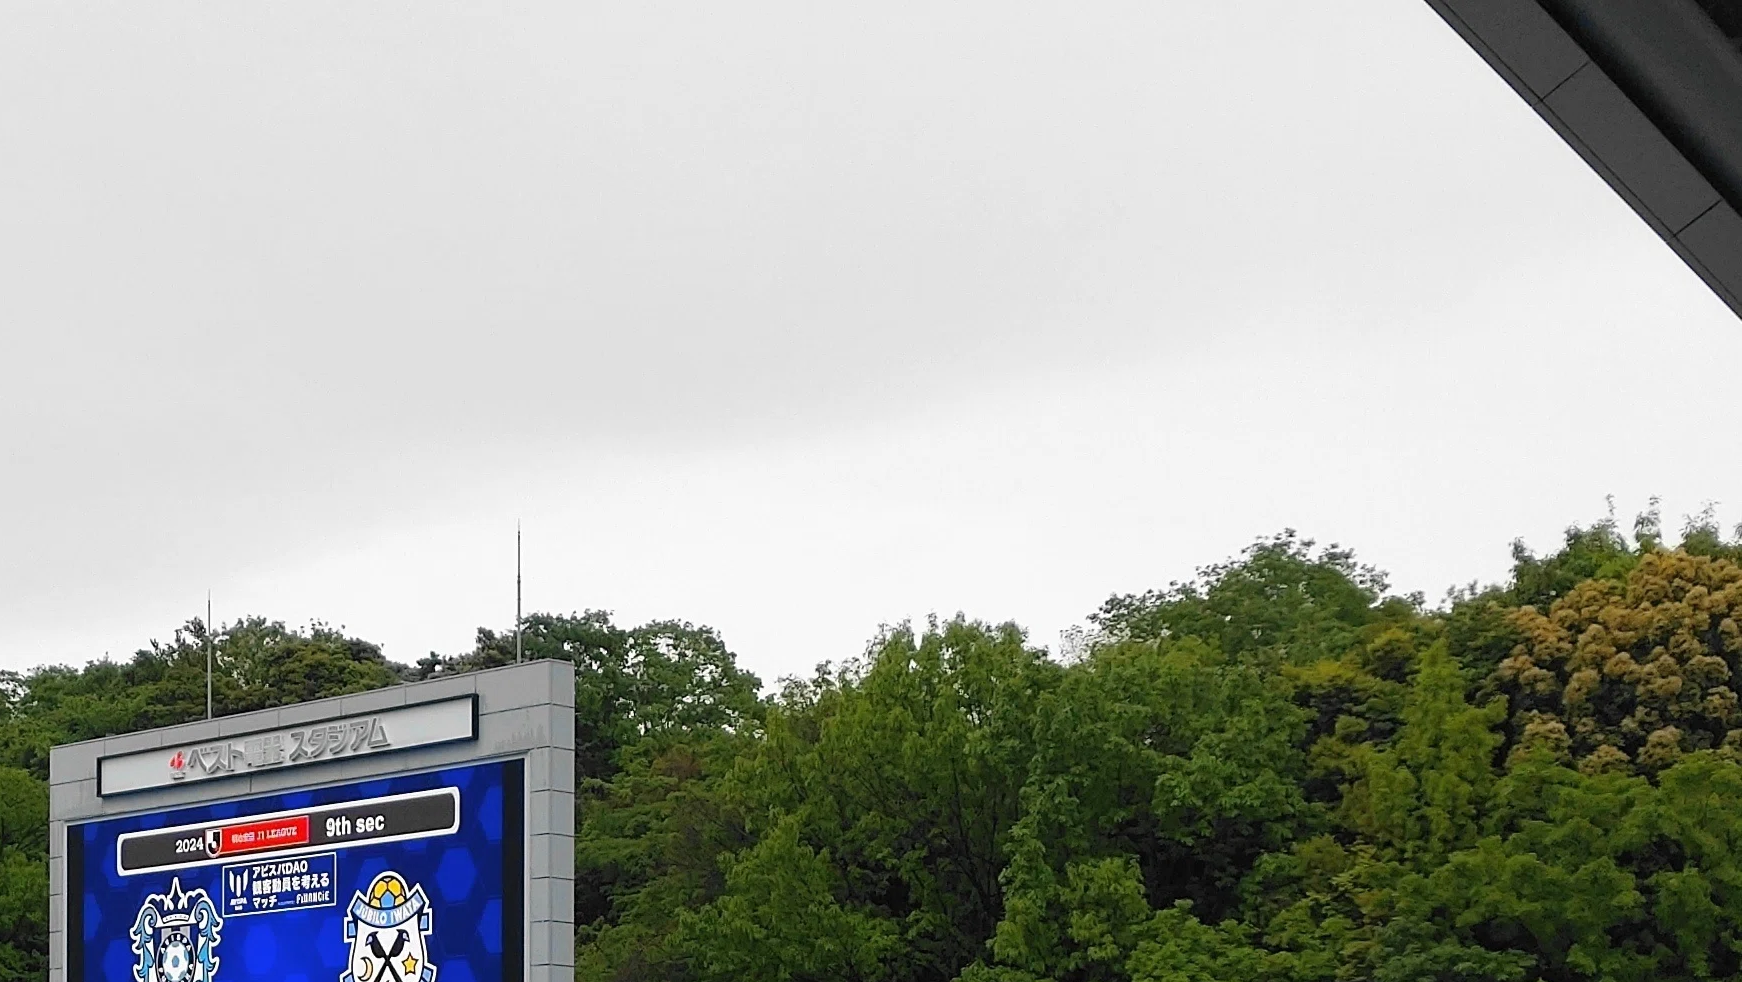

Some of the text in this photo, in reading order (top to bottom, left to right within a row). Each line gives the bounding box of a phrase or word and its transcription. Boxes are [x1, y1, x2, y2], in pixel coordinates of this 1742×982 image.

[289, 716, 391, 762] スタジアム
[266, 826, 298, 839] LEAGUE
[325, 814, 385, 837] 9th sec
[175, 836, 204, 853] 2024
[252, 895, 278, 910] マッチ
